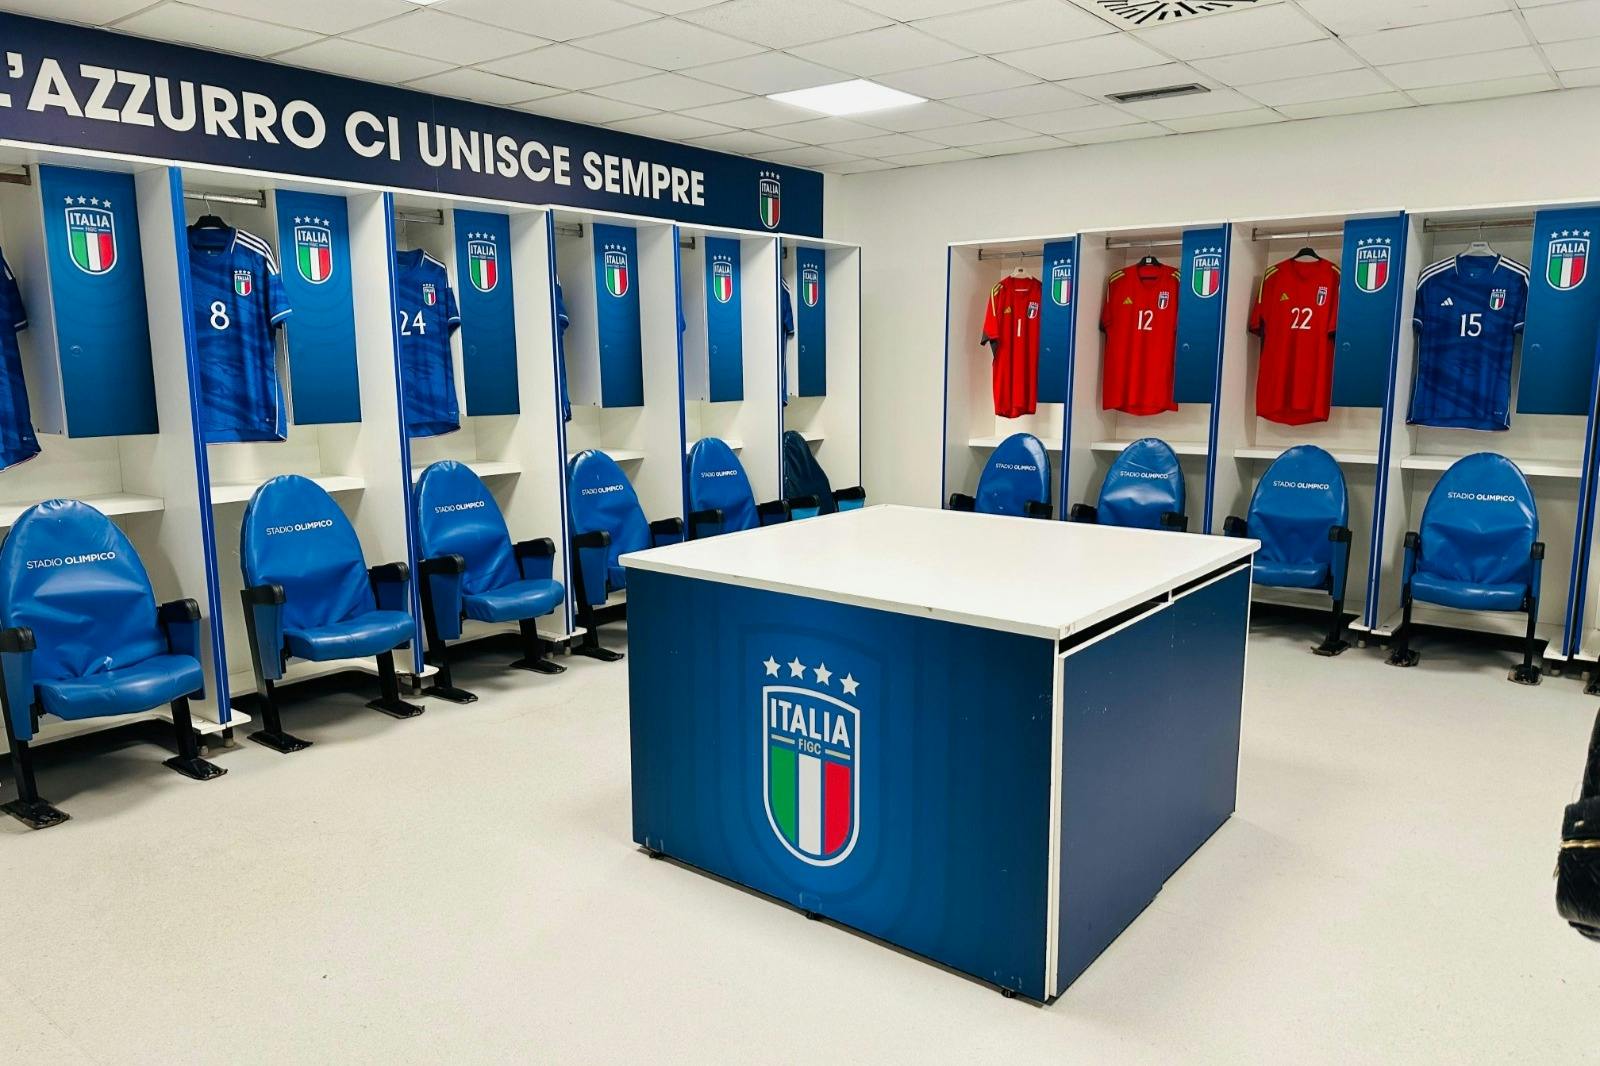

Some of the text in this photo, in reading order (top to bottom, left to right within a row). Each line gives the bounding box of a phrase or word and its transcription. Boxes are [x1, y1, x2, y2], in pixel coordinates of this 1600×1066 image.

[345, 111, 401, 160] CI
[417, 121, 571, 186] UNISCE
[583, 151, 705, 206] SEMPRE
[761, 182, 779, 194] ITALIA
[69, 212, 110, 227] ITALIA
[298, 230, 328, 243] ITALIA
[470, 244, 494, 256] ITALIA
[1359, 249, 1387, 259] ITALIA
[1551, 242, 1585, 254] ITALIA
[606, 255, 626, 265] ITALIA
[1195, 258, 1220, 267] ITALIA
[1054, 268, 1072, 277] ITALI
[210, 301, 230, 330] 8
[1137, 310, 1154, 331] 12
[1291, 307, 1313, 330] 22
[400, 310, 426, 336] 24
[1016, 318, 1022, 337] 1
[1460, 313, 1482, 337] 15
[1120, 470, 1140, 478] STADIO
[581, 484, 624, 496] STADIO OLIMPICO
[1272, 480, 1329, 490] STADIO OLIMPICO
[1447, 491, 1515, 502] STADIO OLIMPICO
[434, 500, 485, 514] STADIO OLIMPICO
[266, 519, 333, 536] STADIO OLIMPICO
[26, 551, 116, 569] STADIO OLIMPICO
[770, 697, 851, 749] ITALIA
[798, 738, 822, 755] FIGC
